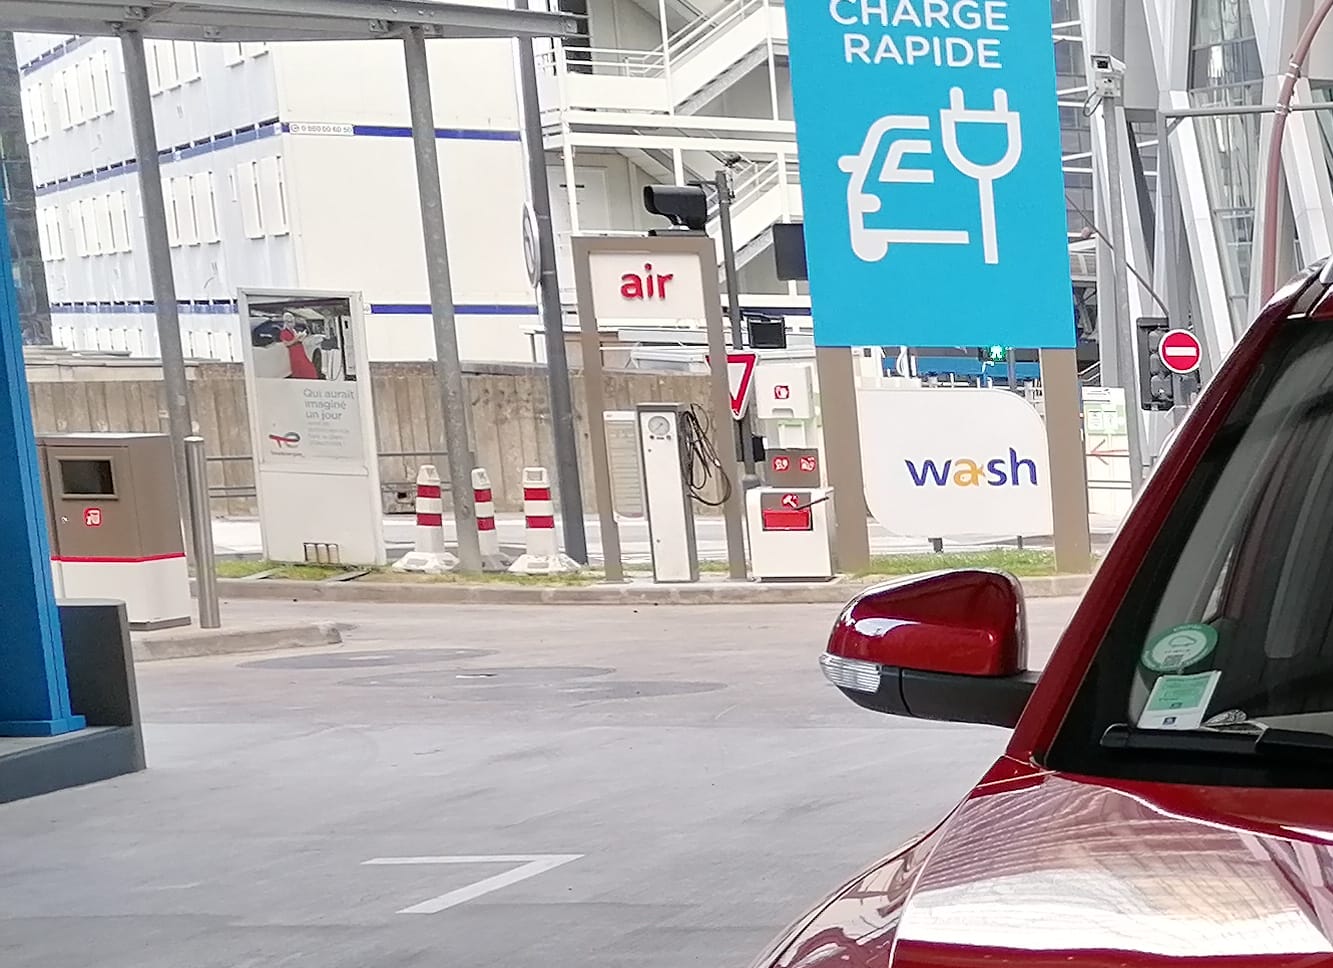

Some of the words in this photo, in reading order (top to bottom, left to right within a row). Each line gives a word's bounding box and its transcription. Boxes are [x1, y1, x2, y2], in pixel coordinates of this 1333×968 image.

[829, 0, 1010, 31] CHARGE
[843, 33, 1003, 69] RAPIDE
[620, 263, 674, 300] air
[904, 447, 1038, 487] wash
